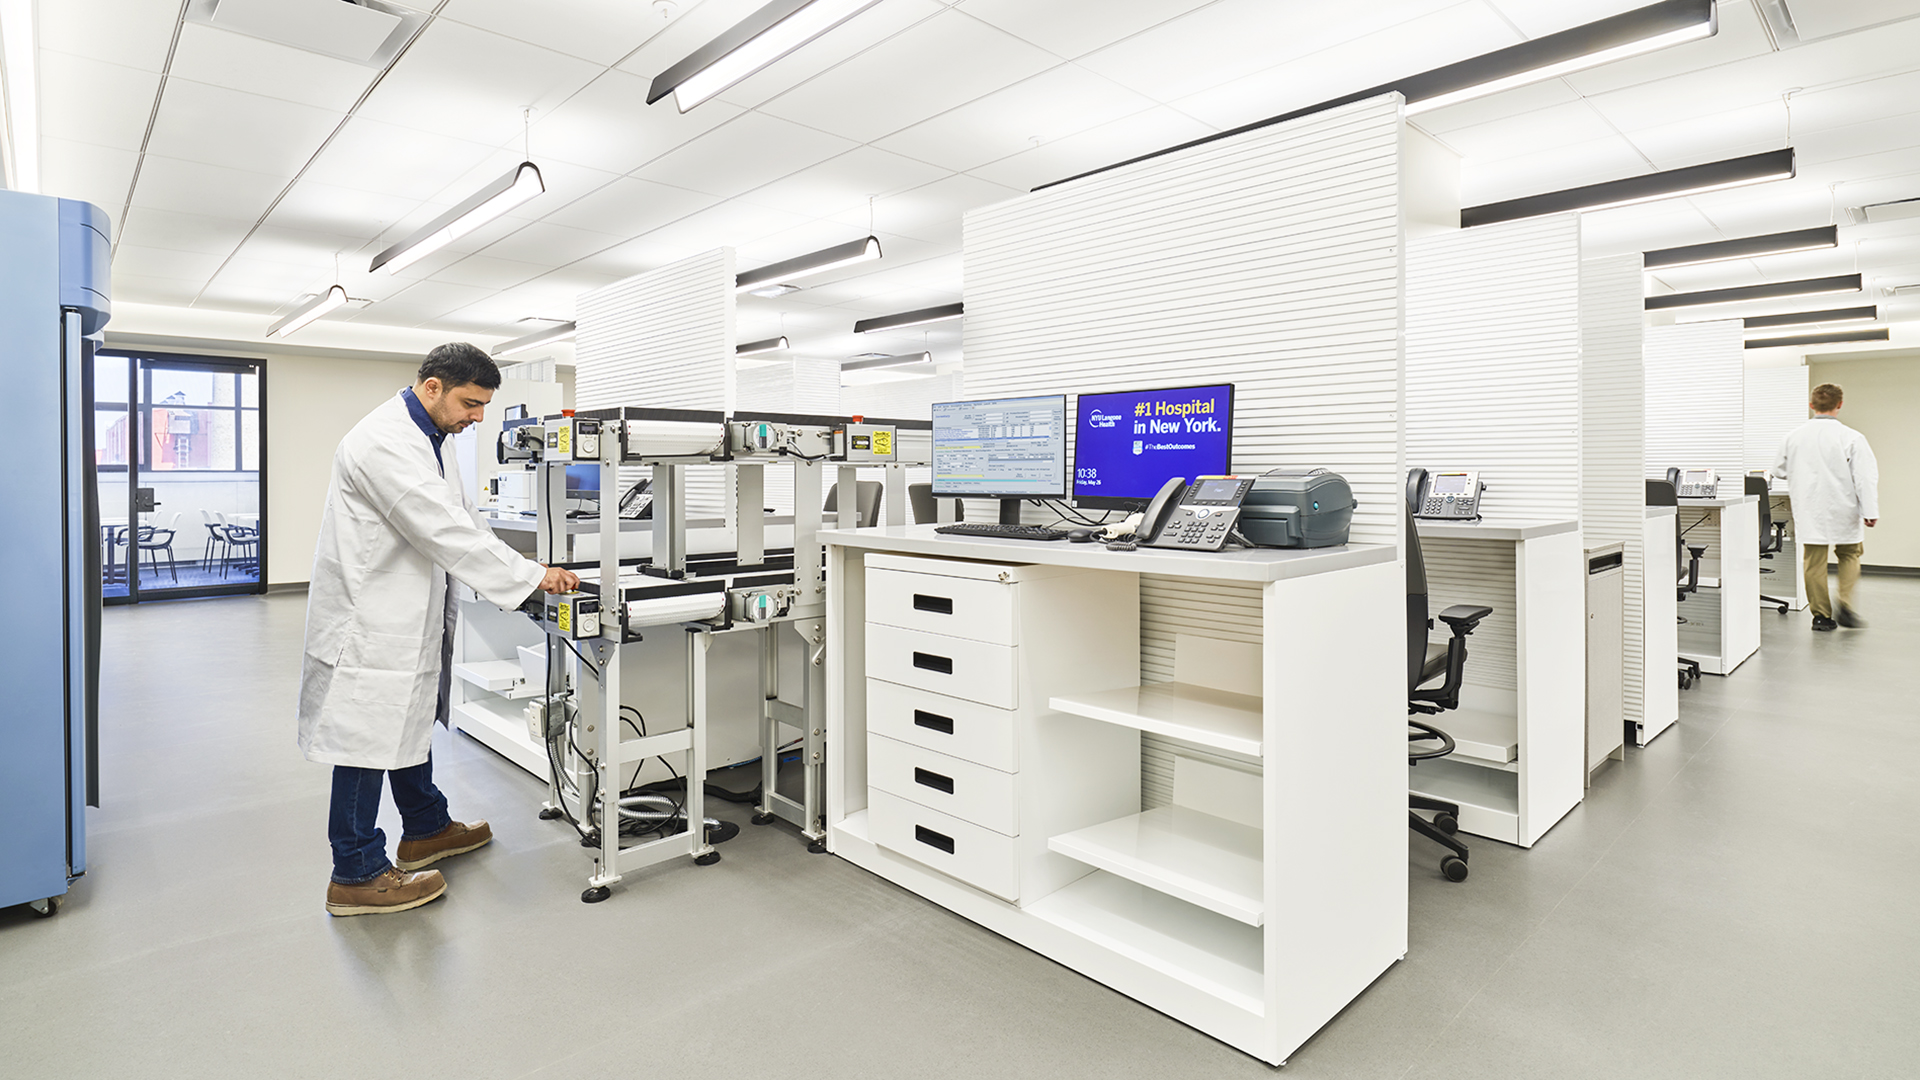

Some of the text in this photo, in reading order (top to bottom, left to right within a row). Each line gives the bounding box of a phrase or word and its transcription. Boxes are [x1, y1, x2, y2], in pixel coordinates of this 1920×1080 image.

[1134, 398, 1215, 418] #1 Hospital
[1133, 417, 1221, 434] in New York.
[1077, 468, 1097, 479] 10:38
